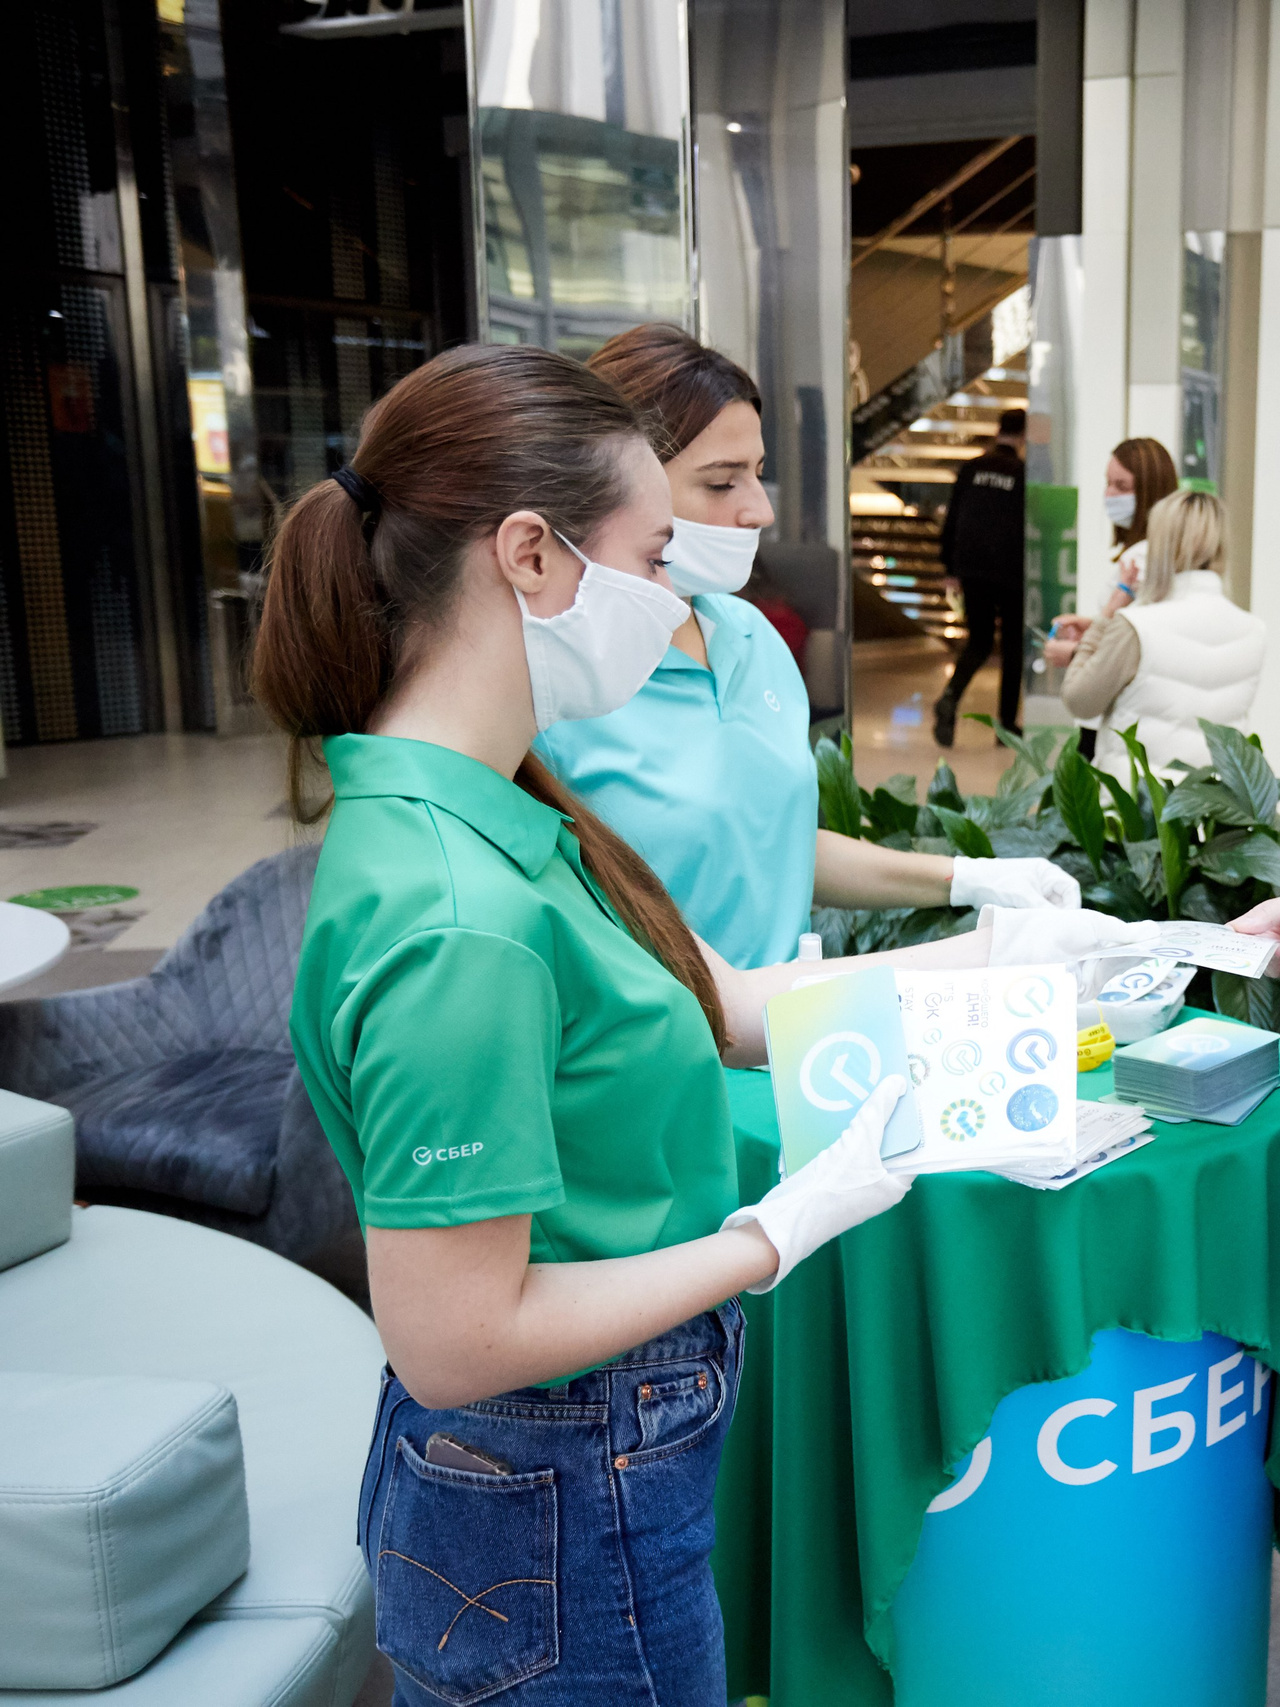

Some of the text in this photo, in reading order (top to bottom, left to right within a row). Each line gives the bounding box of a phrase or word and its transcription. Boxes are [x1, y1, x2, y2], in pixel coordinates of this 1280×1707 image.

[904, 987, 914, 1011] STAY
[966, 993, 979, 1027] ДНЯ!
[436, 1141, 484, 1161] СБЕР
